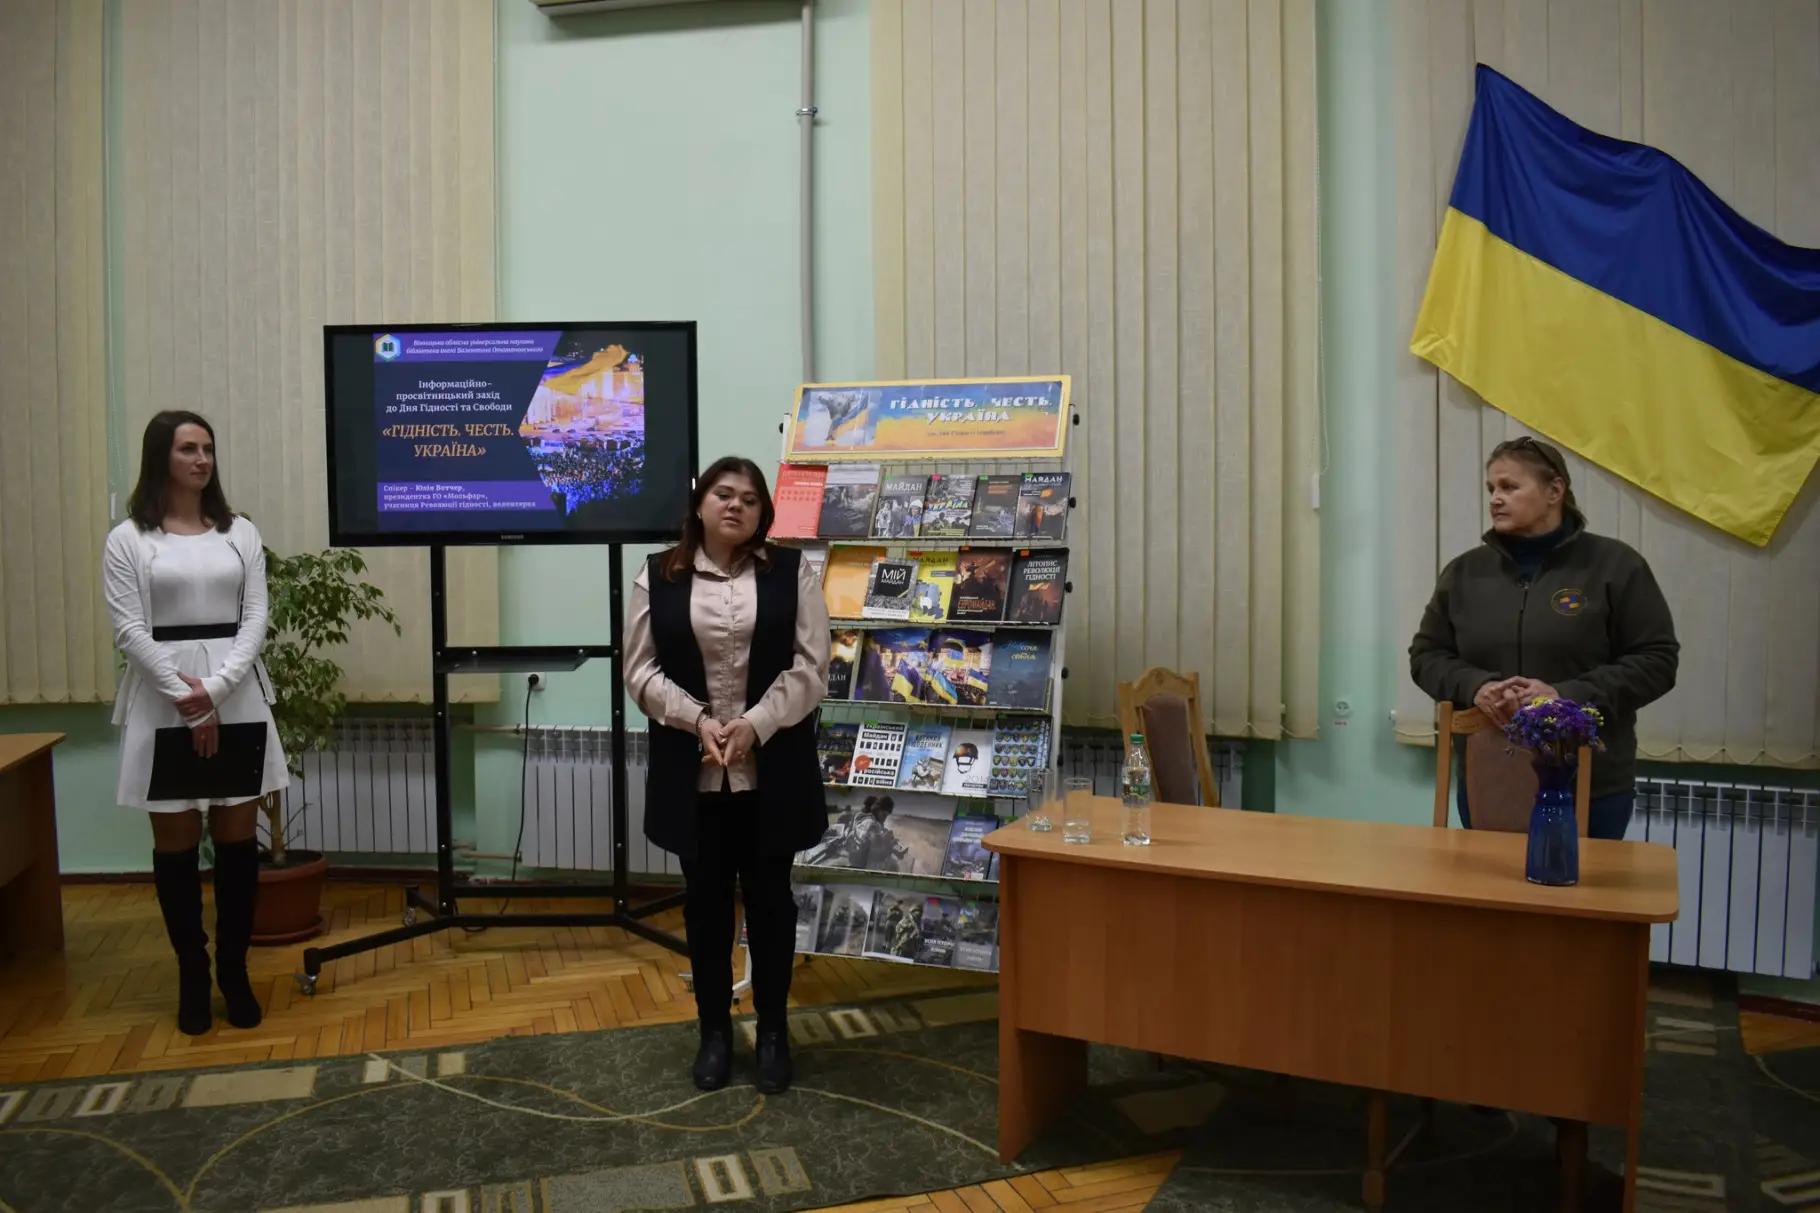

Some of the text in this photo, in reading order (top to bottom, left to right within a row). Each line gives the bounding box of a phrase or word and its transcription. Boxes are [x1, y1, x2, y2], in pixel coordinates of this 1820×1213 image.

[396, 391, 500, 402] просвітницький захід
[386, 405, 397, 413] до
[399, 404, 418, 413] Дня
[420, 403, 458, 412] Гідності
[472, 403, 512, 412] Свободи
[927, 409, 1009, 425] УКРАЇНА
[382, 423, 514, 439] «ГІДНІСТЬ. ЧЕСТЬ.
[414, 441, 486, 457] УКРАЇНА»
[383, 485, 408, 493] Спікер
[383, 493, 431, 501] президентка
[881, 568, 906, 580] МІЙ
